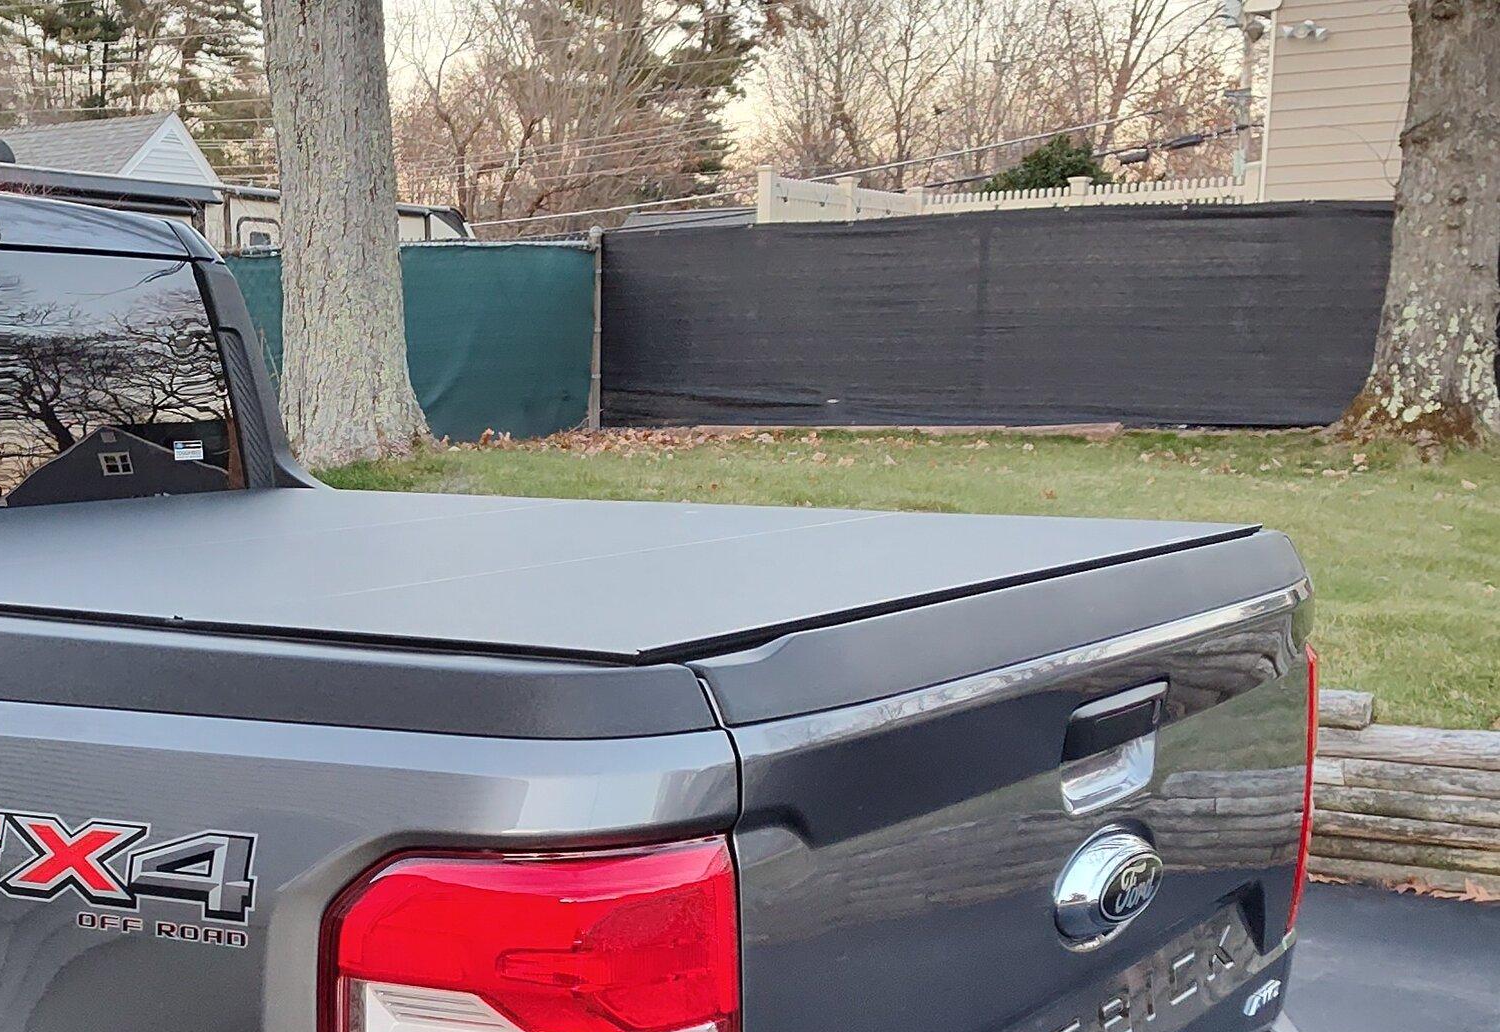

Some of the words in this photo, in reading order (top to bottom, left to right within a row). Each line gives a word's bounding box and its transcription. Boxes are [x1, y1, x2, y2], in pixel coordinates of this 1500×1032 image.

[1114, 860, 1158, 914] Ford
[77, 911, 144, 934] OFF
[155, 921, 249, 949] ROAD
